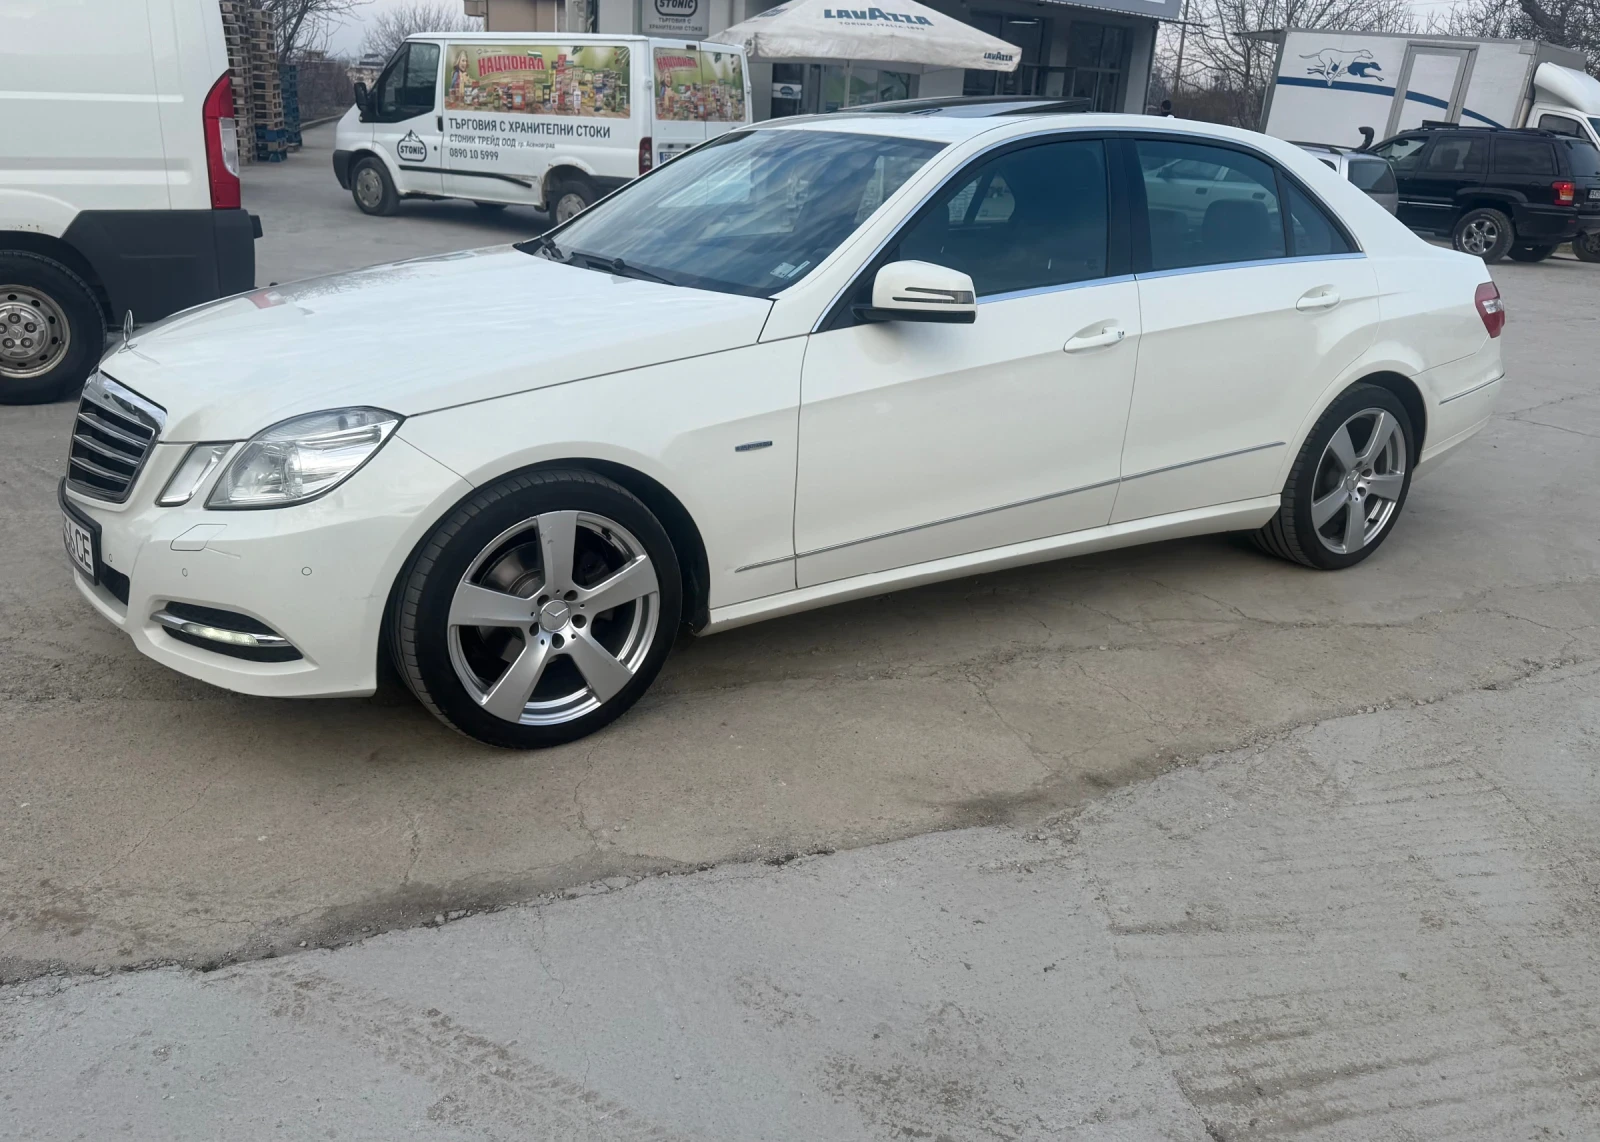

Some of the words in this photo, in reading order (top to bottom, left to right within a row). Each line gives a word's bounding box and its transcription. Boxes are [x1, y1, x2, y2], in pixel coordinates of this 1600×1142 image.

[659, 0, 694, 9] STONIC
[824, 7, 935, 27] LAVAZZA
[983, 51, 1013, 62] LAVAZZA
[477, 55, 545, 77] НАЦИОНАЛ
[448, 117, 497, 132] ТЪРГОВИЯ
[499, 120, 506, 132] С
[508, 120, 574, 136] ХРАНИТЕЛНИ
[576, 124, 611, 139] СТОКИ
[449, 133, 476, 144] СТОНИК
[477, 134, 500, 147] ТРЕЙД
[501, 137, 516, 148] ООД
[400, 145, 424, 155] STONIC
[449, 147, 468, 159] 0890
[469, 149, 479, 159] 10
[480, 150, 499, 161] 5999
